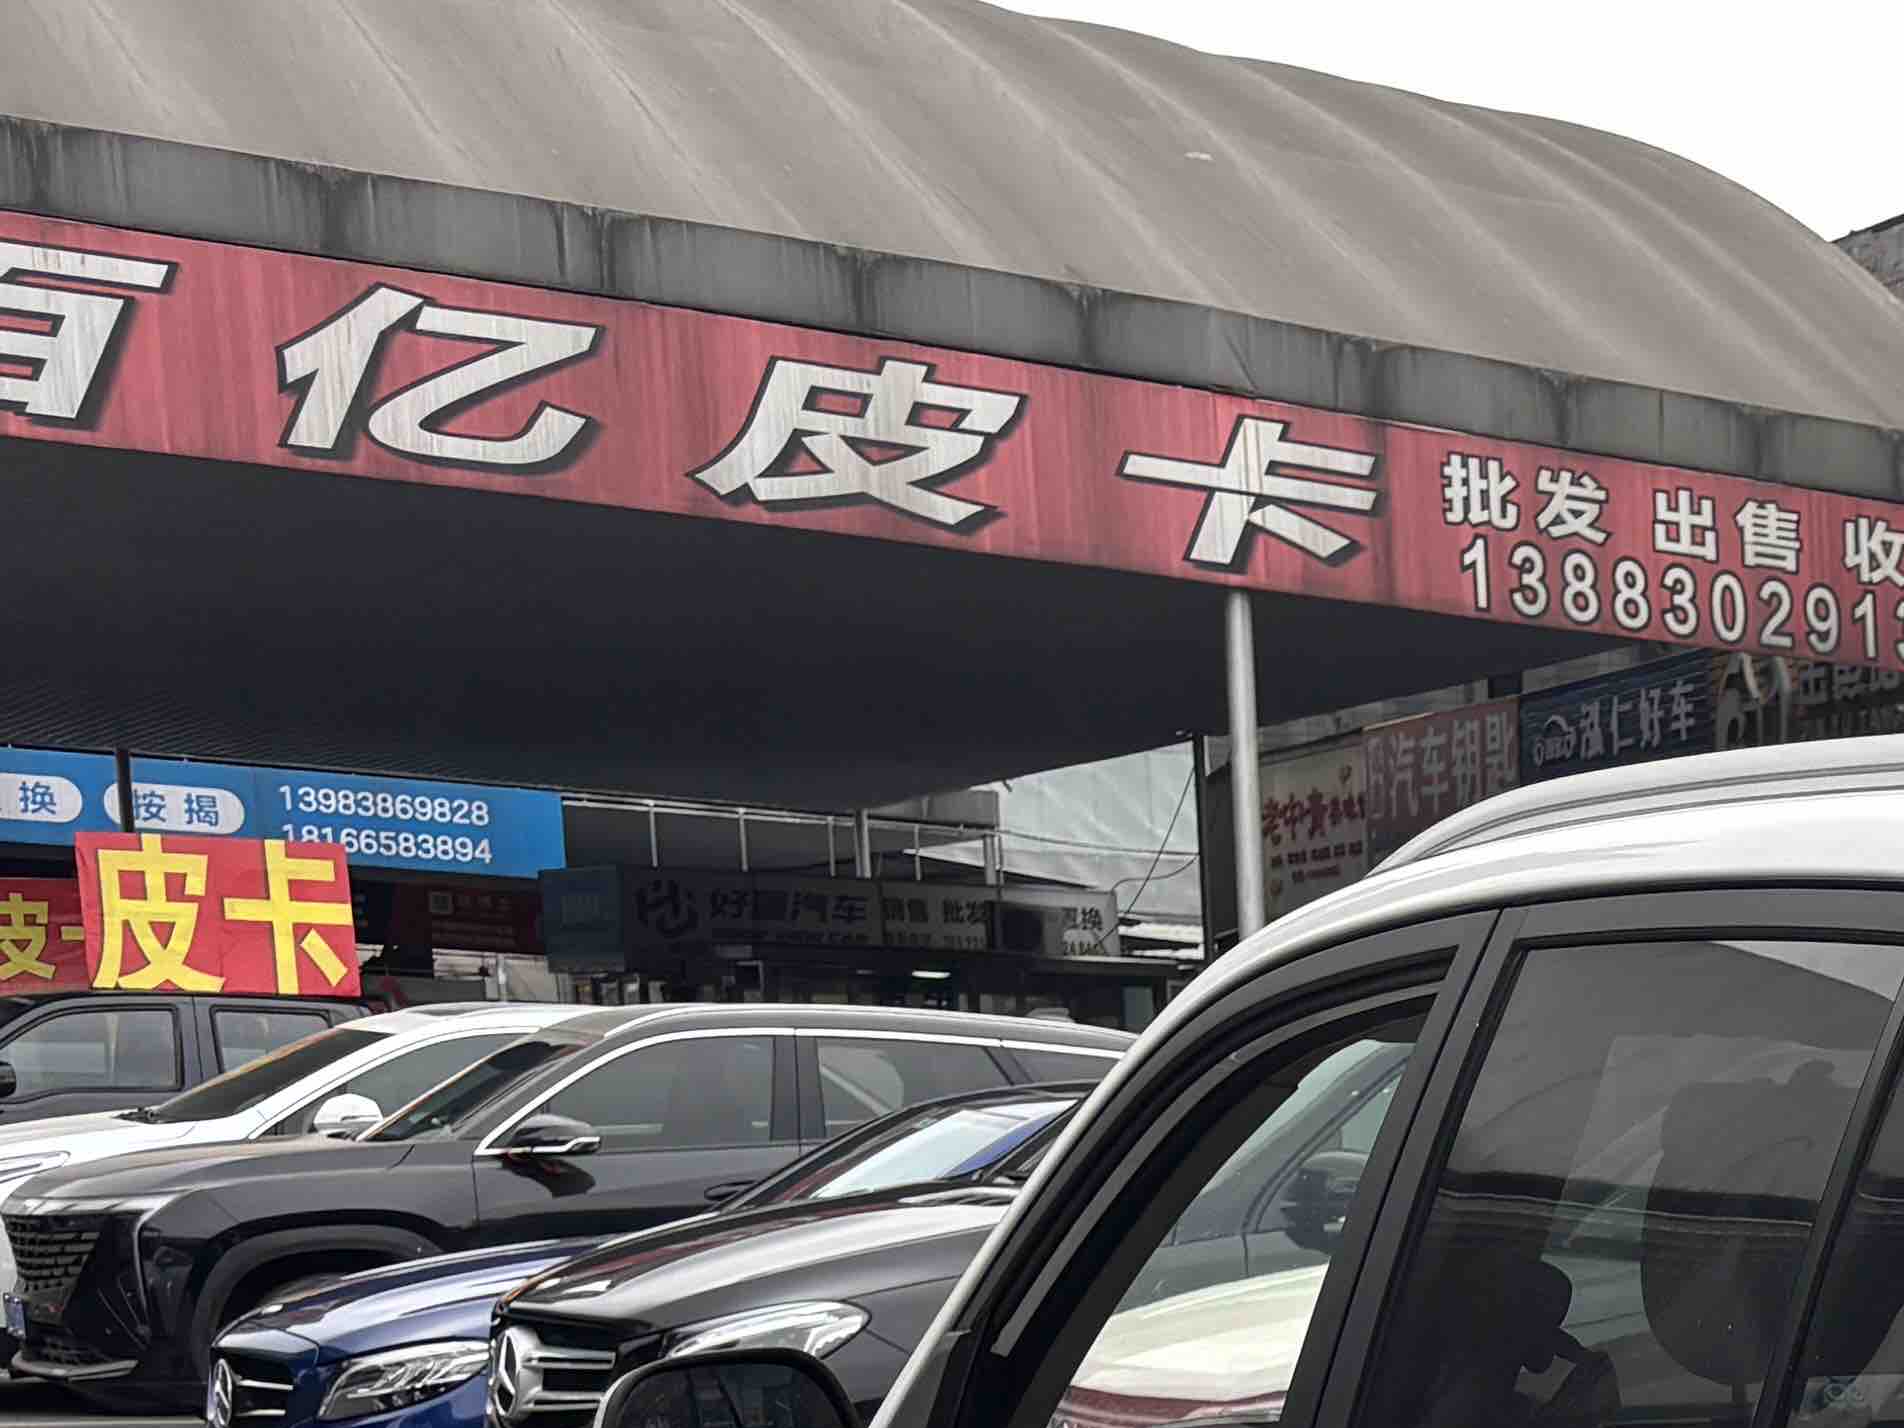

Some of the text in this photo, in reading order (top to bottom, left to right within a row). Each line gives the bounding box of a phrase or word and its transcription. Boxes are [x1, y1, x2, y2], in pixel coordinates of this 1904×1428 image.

[1441, 452, 1609, 545] 批发
[1655, 488, 1802, 570] 出售
[279, 784, 490, 827] 13983869828
[0, 892, 84, 981] 皮
[92, 832, 354, 995] 皮卡
